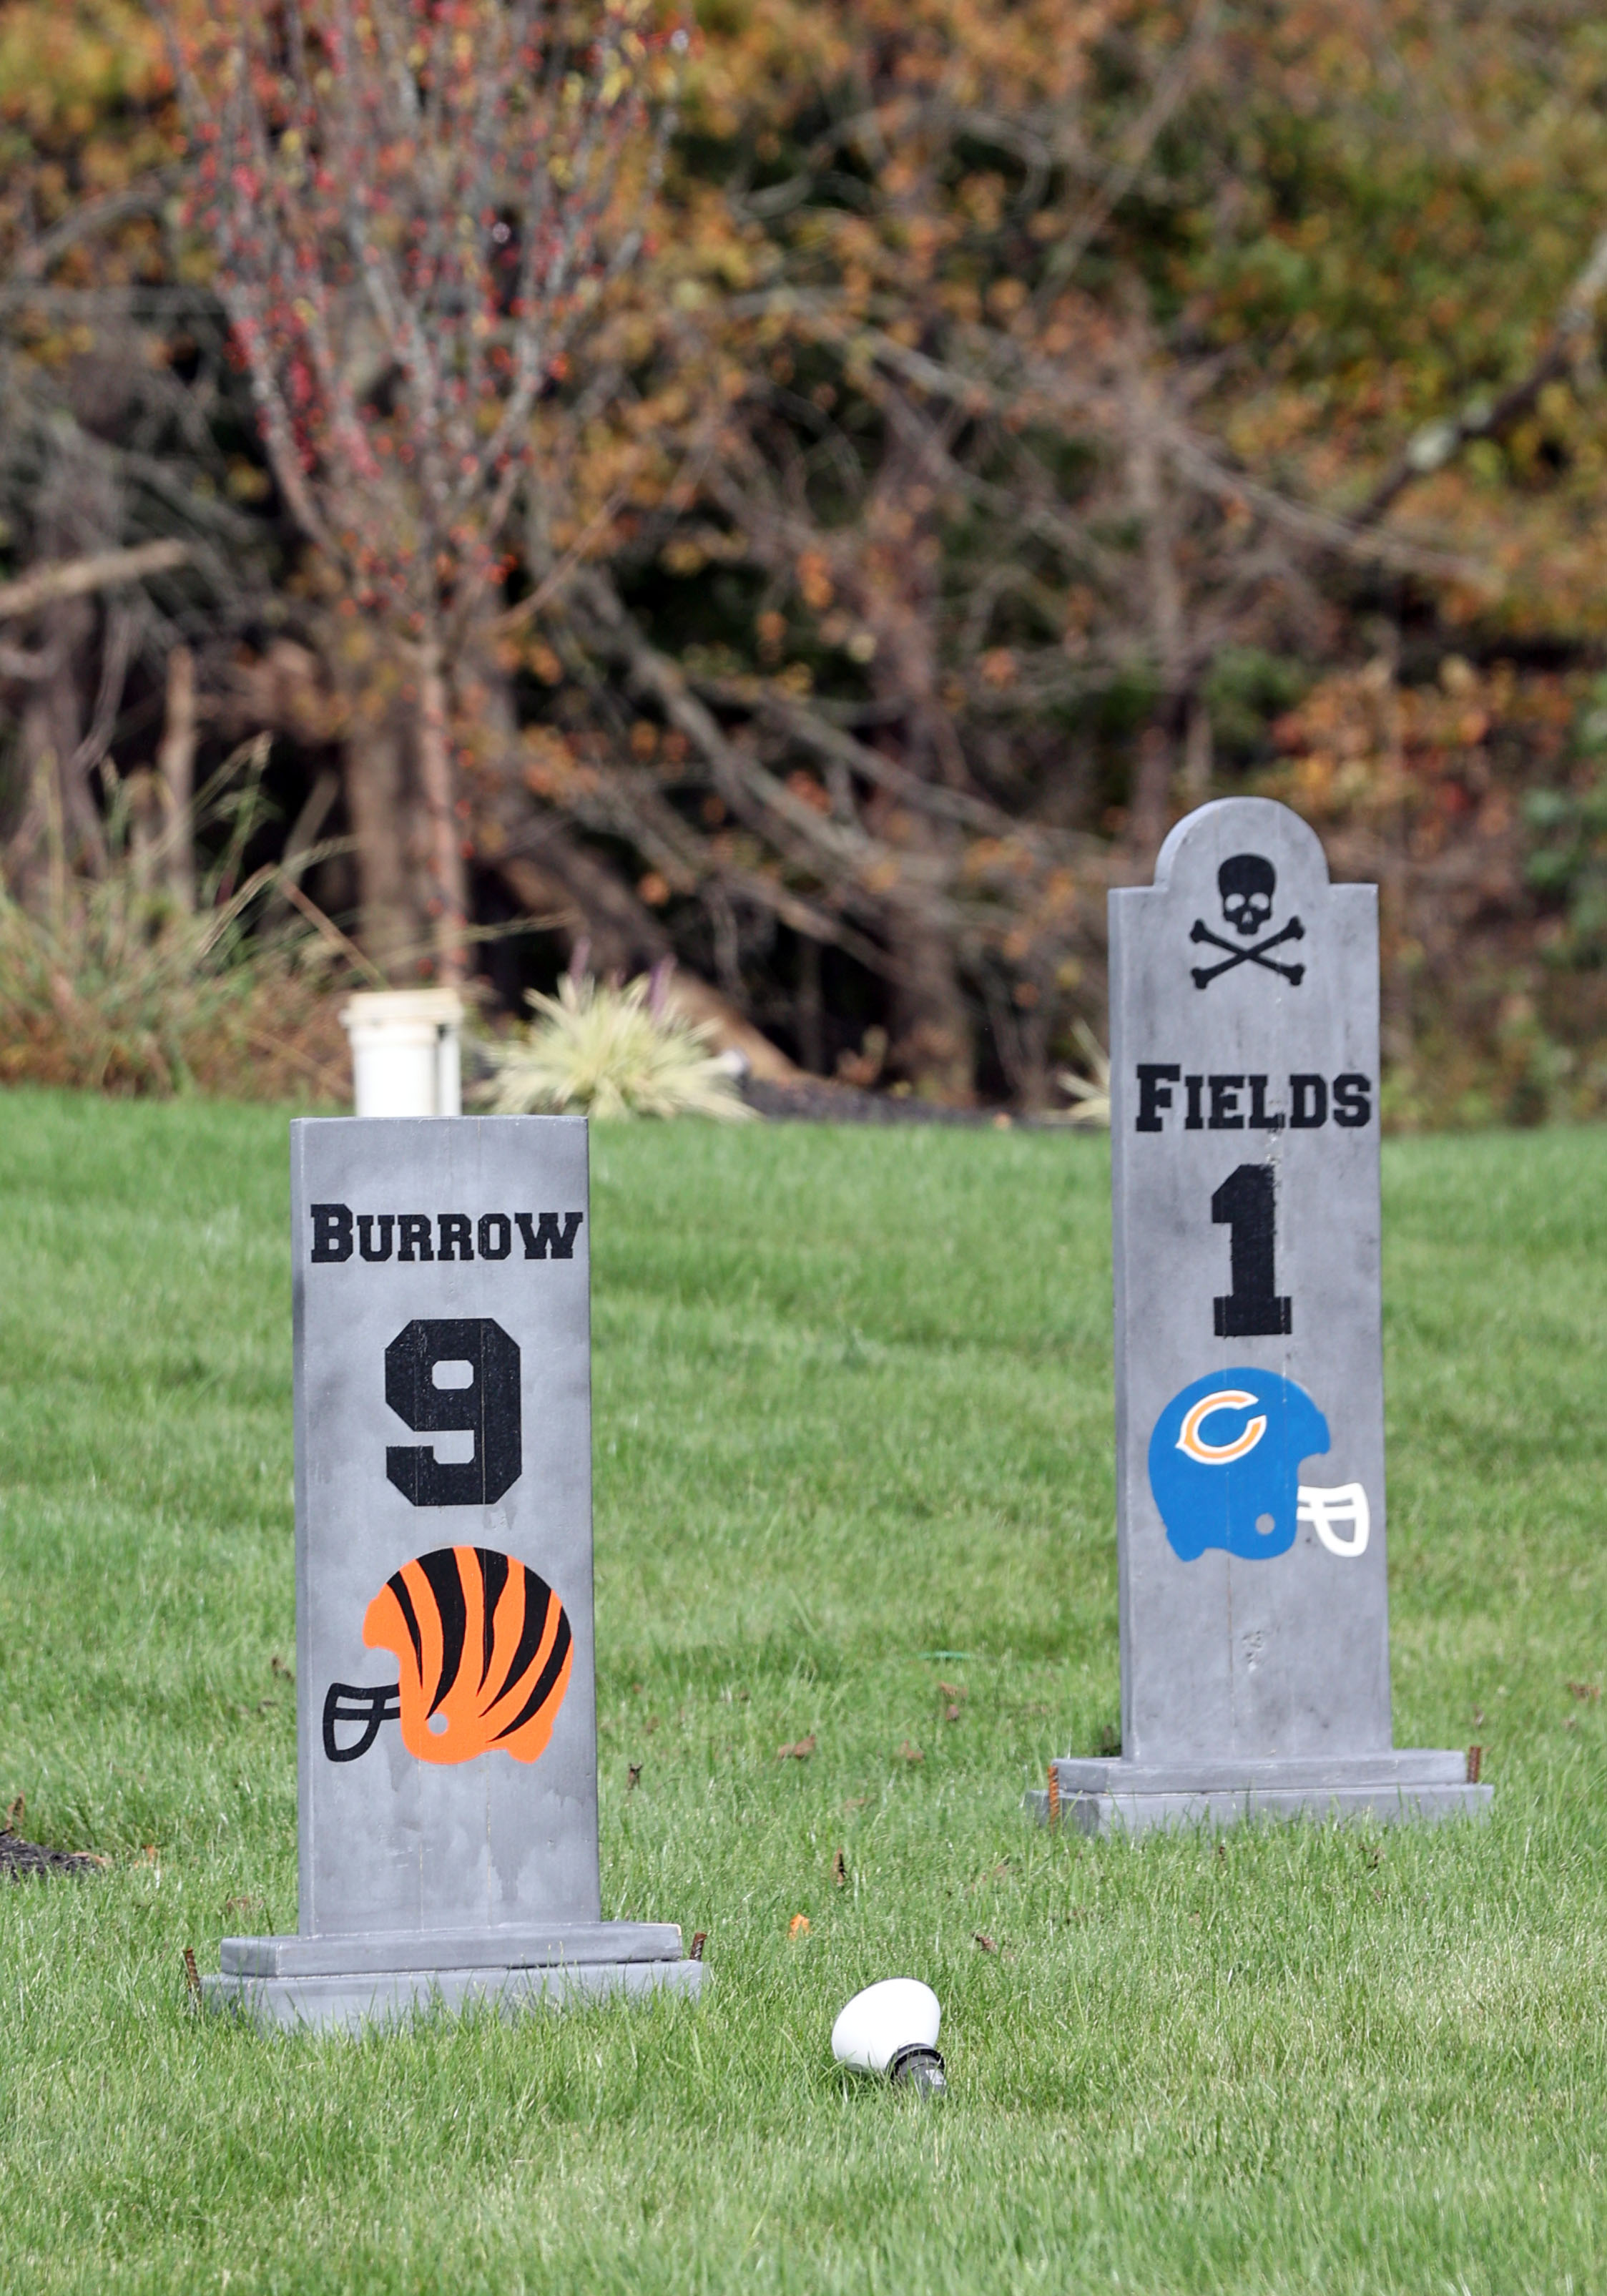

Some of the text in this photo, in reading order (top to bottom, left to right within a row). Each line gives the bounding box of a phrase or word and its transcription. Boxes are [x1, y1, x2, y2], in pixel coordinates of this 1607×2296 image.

[310, 1204, 584, 1263] BURROW
[1211, 1164, 1293, 1337] 1
[385, 1318, 522, 1506] 9
[1176, 1390, 1268, 1466] C
